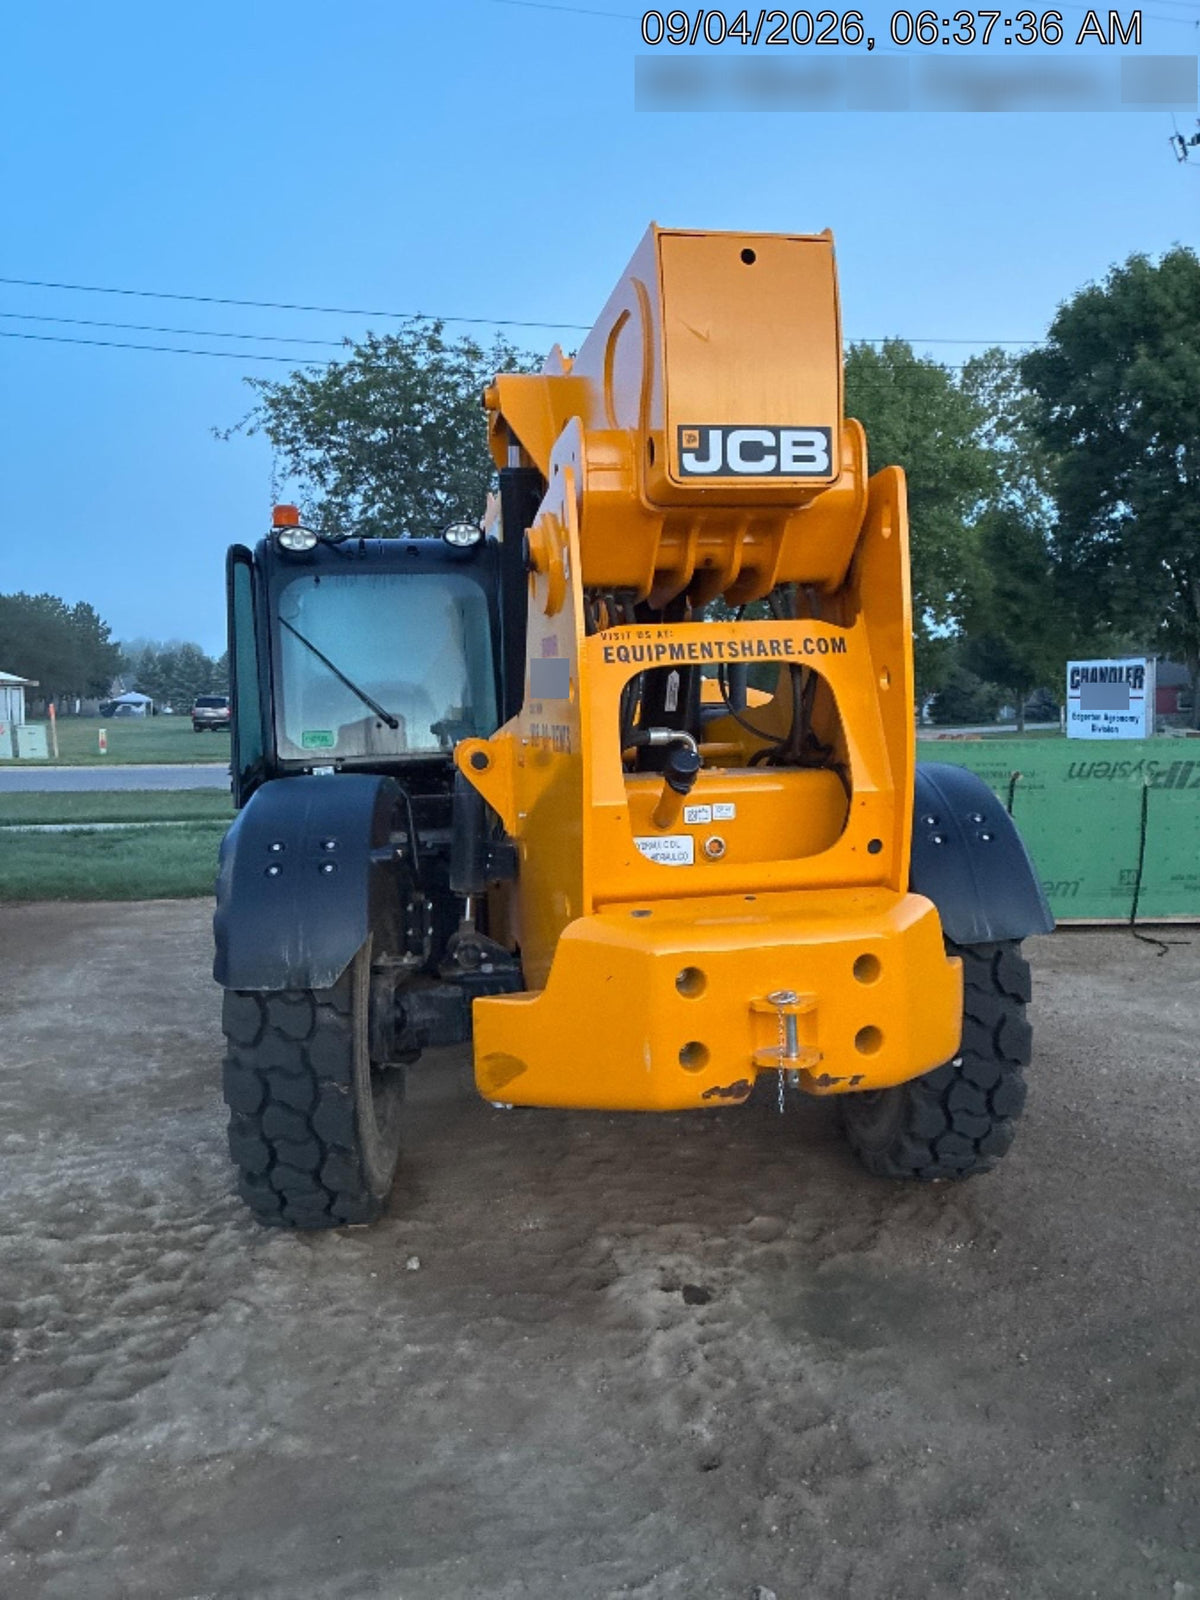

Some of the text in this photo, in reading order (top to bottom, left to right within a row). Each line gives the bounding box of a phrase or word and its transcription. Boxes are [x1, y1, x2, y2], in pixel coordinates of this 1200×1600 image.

[682, 430, 829, 473] JCB
[603, 637, 847, 663] EQUIPMENTSHARE.COM
[1070, 665, 1144, 689] CHANDLER
